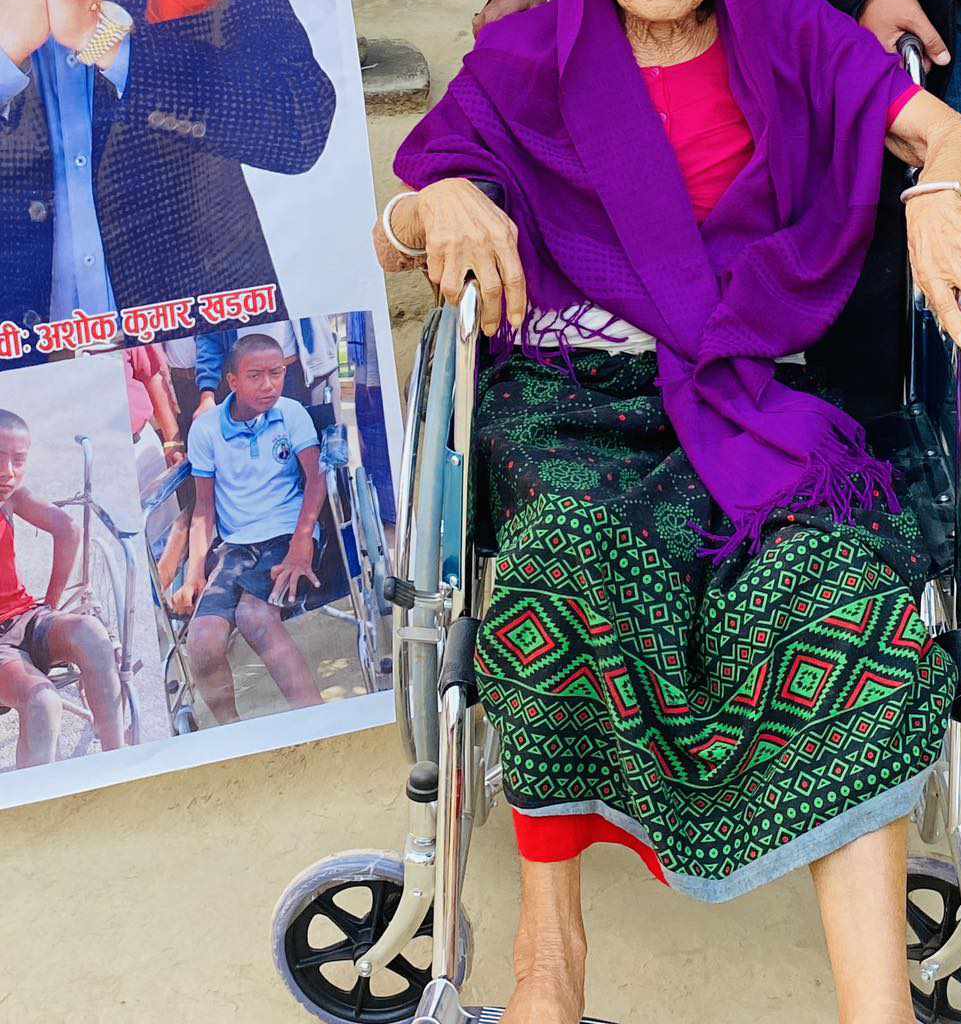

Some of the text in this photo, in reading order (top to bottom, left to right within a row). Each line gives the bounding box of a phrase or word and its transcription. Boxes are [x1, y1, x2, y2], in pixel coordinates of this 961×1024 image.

[34, 309, 118, 353] अशोक
[121, 296, 196, 342] कुमार
[198, 283, 277, 324] खड्का
